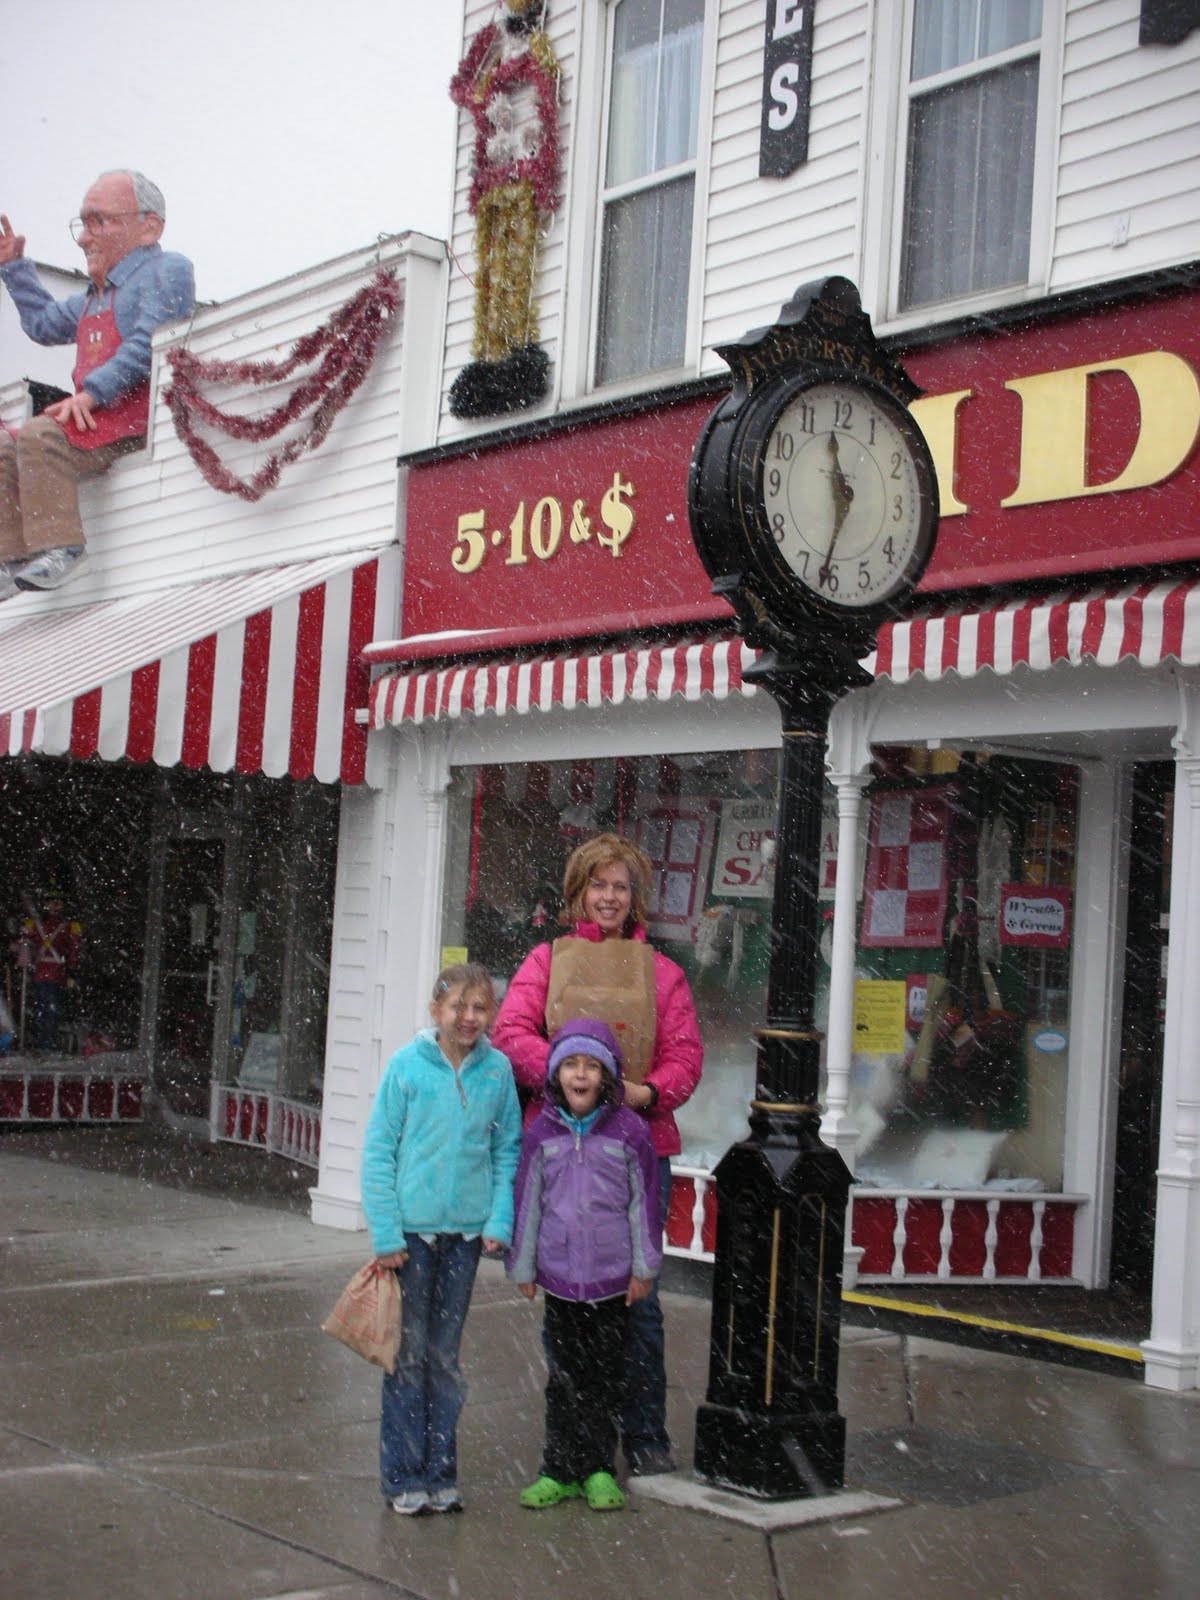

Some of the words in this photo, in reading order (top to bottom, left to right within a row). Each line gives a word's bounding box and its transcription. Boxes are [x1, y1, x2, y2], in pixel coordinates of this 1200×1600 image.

[801, 402, 815, 434] 11
[833, 401, 853, 430] 12
[776, 431, 794, 461] 10
[868, 418, 876, 446] 1
[891, 452, 903, 480] 2
[769, 468, 781, 497] 9
[570, 499, 591, 544] &
[597, 471, 634, 557] $
[892, 495, 903, 522] 3
[772, 513, 785, 543] 8
[797, 550, 810, 579] 7
[882, 536, 896, 564] 4
[827, 564, 839, 592] 6
[858, 560, 871, 589] 5
[1020, 919, 1062, 932] Greens
